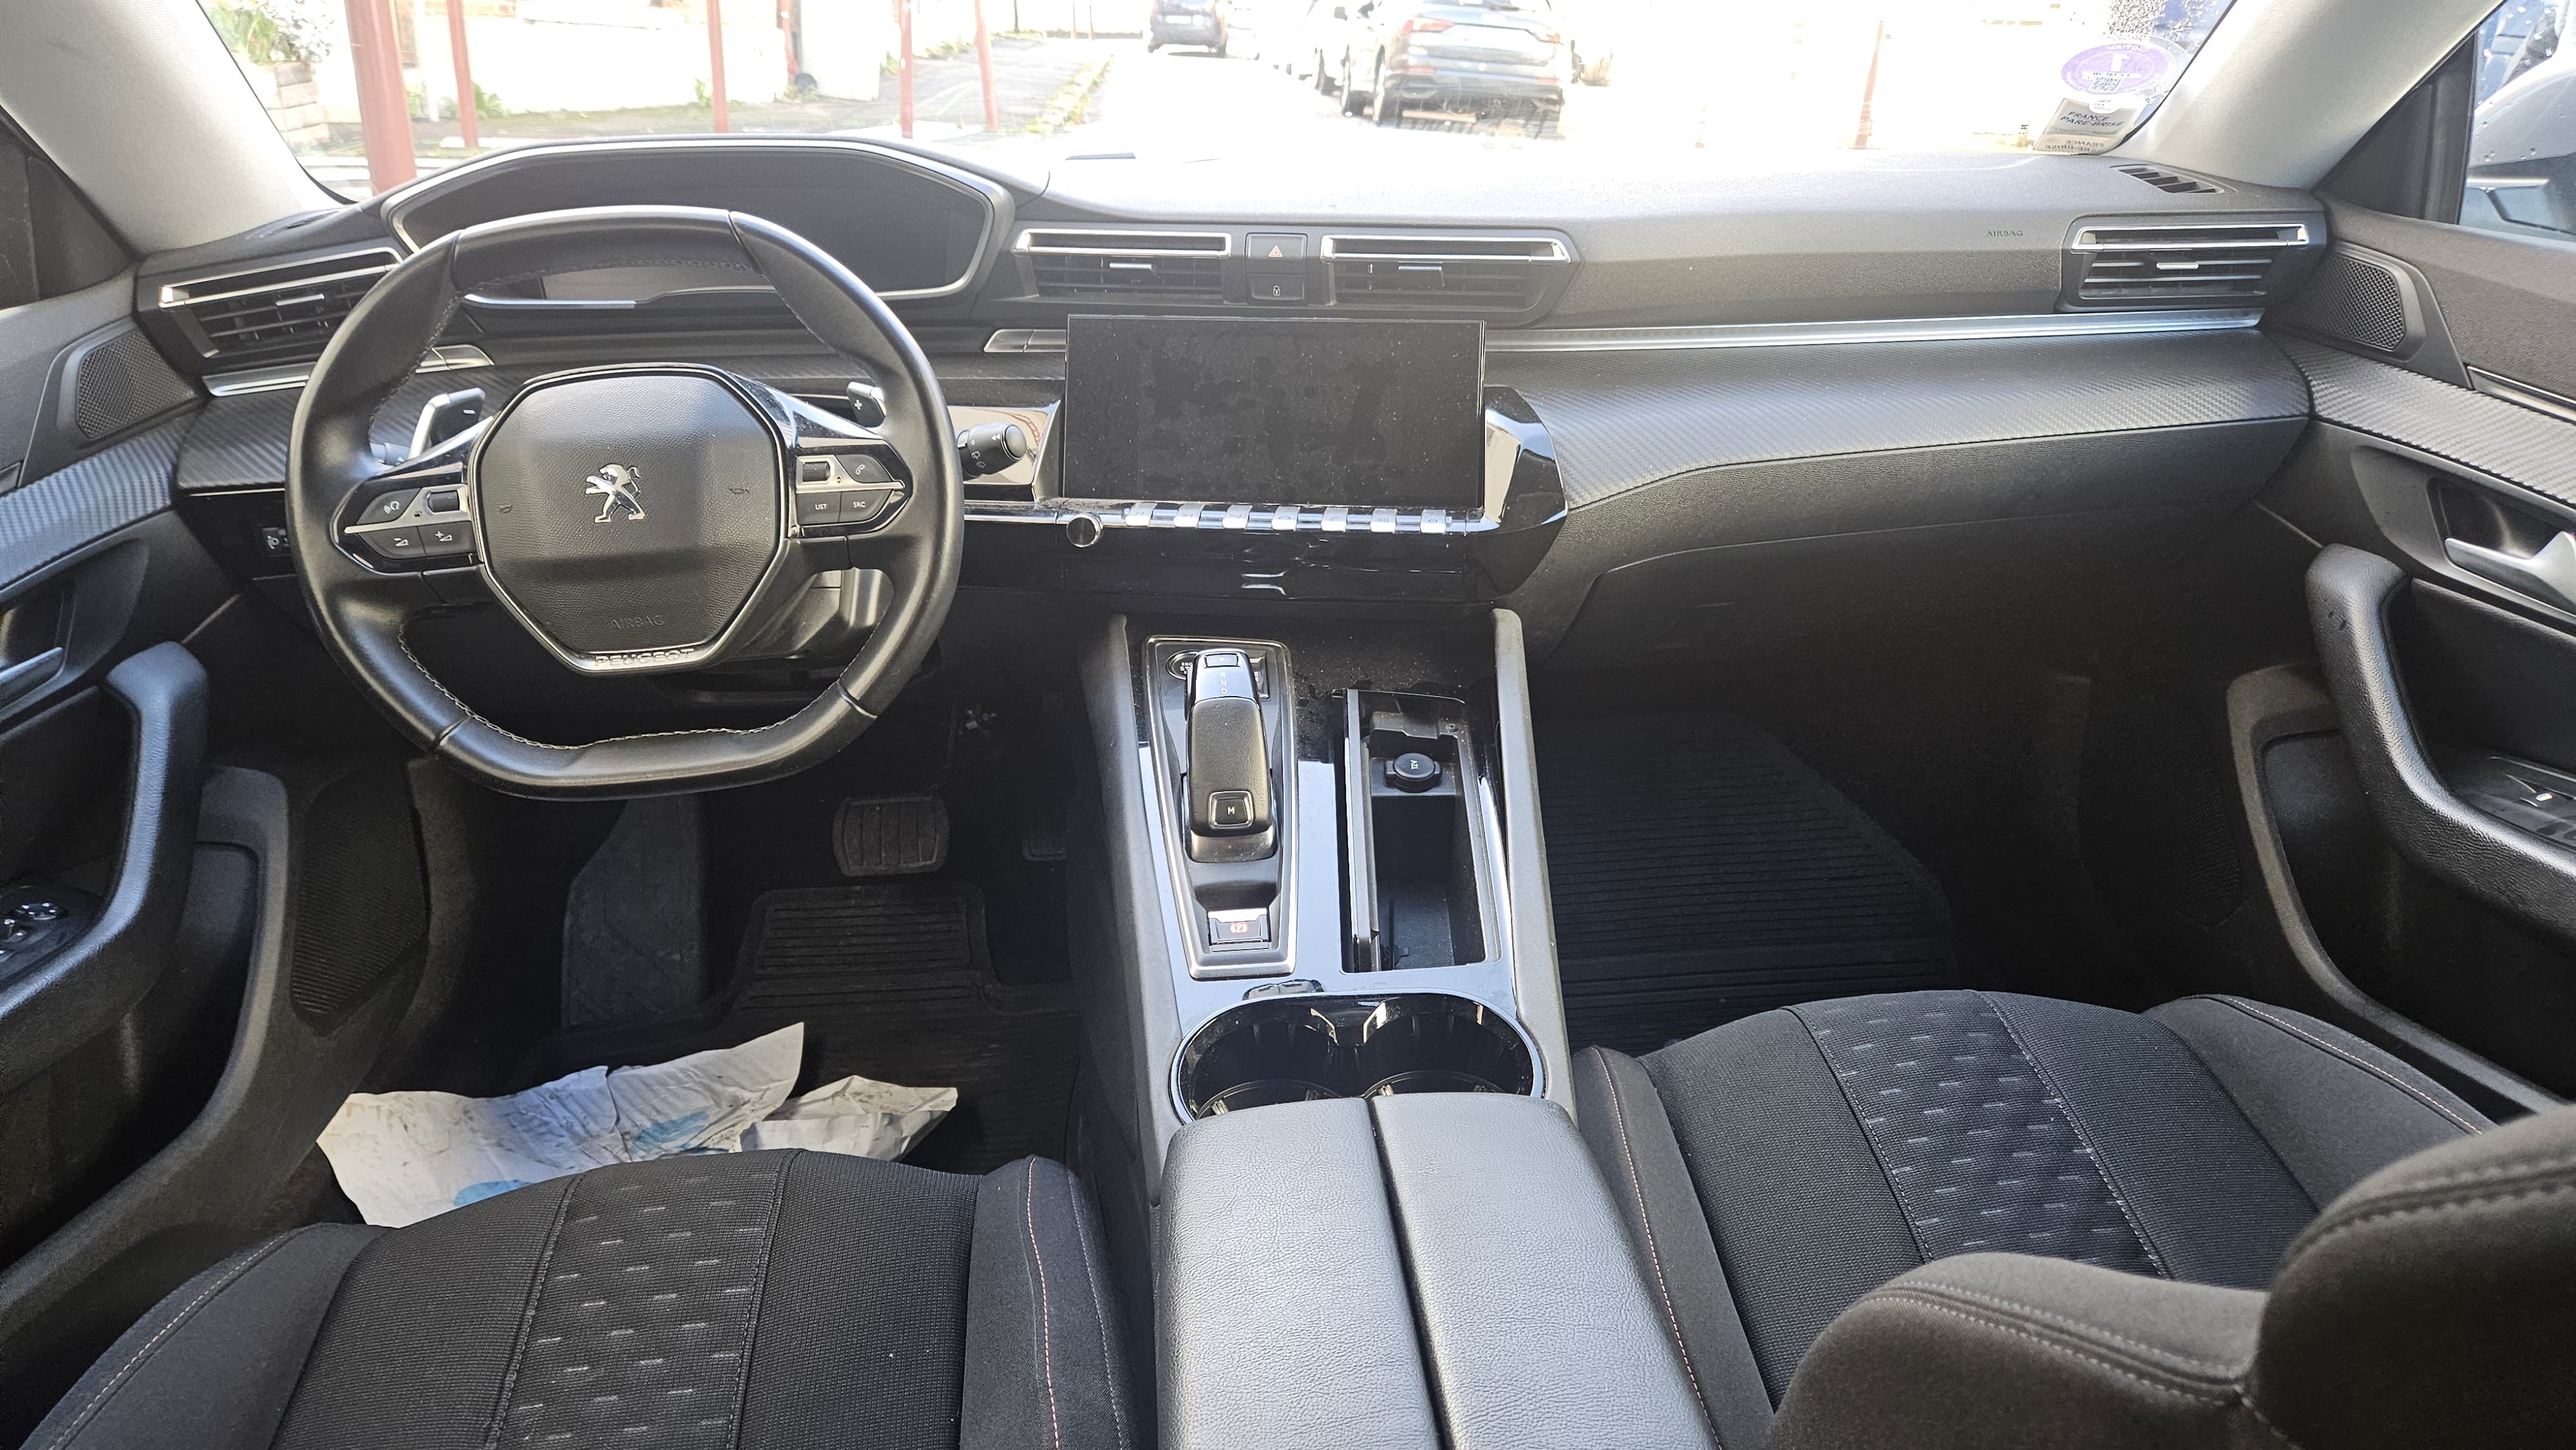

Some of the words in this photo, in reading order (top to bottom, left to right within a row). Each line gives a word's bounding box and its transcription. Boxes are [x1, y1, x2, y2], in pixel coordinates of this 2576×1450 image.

[2060, 116, 2125, 126] PARE-BRISE
[2068, 111, 2110, 121] FRANCE
[610, 614, 665, 629] AIRBAG
[595, 648, 694, 666] PEUGEOT
[1410, 760, 1419, 770] 12V
[1227, 806, 1235, 814] M
